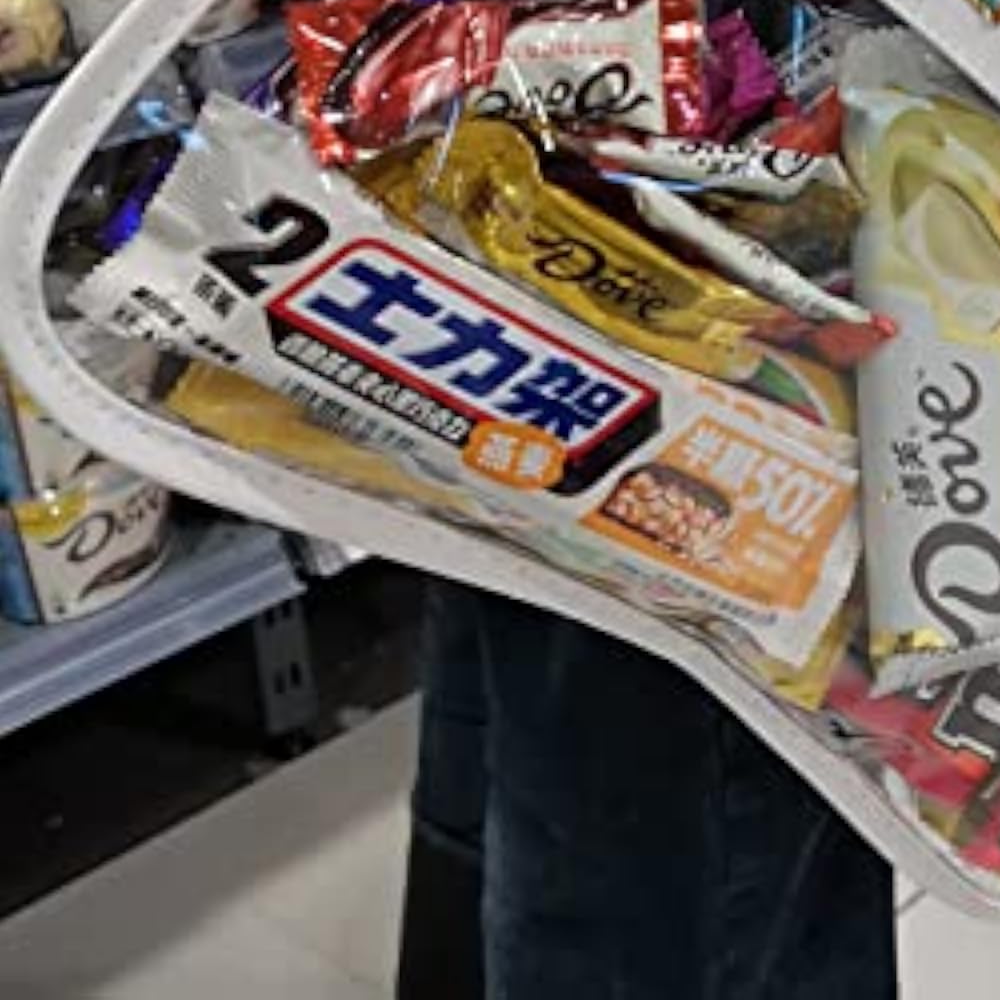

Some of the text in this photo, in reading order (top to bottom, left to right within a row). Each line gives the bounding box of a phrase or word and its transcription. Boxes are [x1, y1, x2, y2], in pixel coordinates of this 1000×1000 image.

[203, 195, 330, 297] 2
[525, 230, 668, 320] Dove
[306, 260, 631, 442] 士力架
